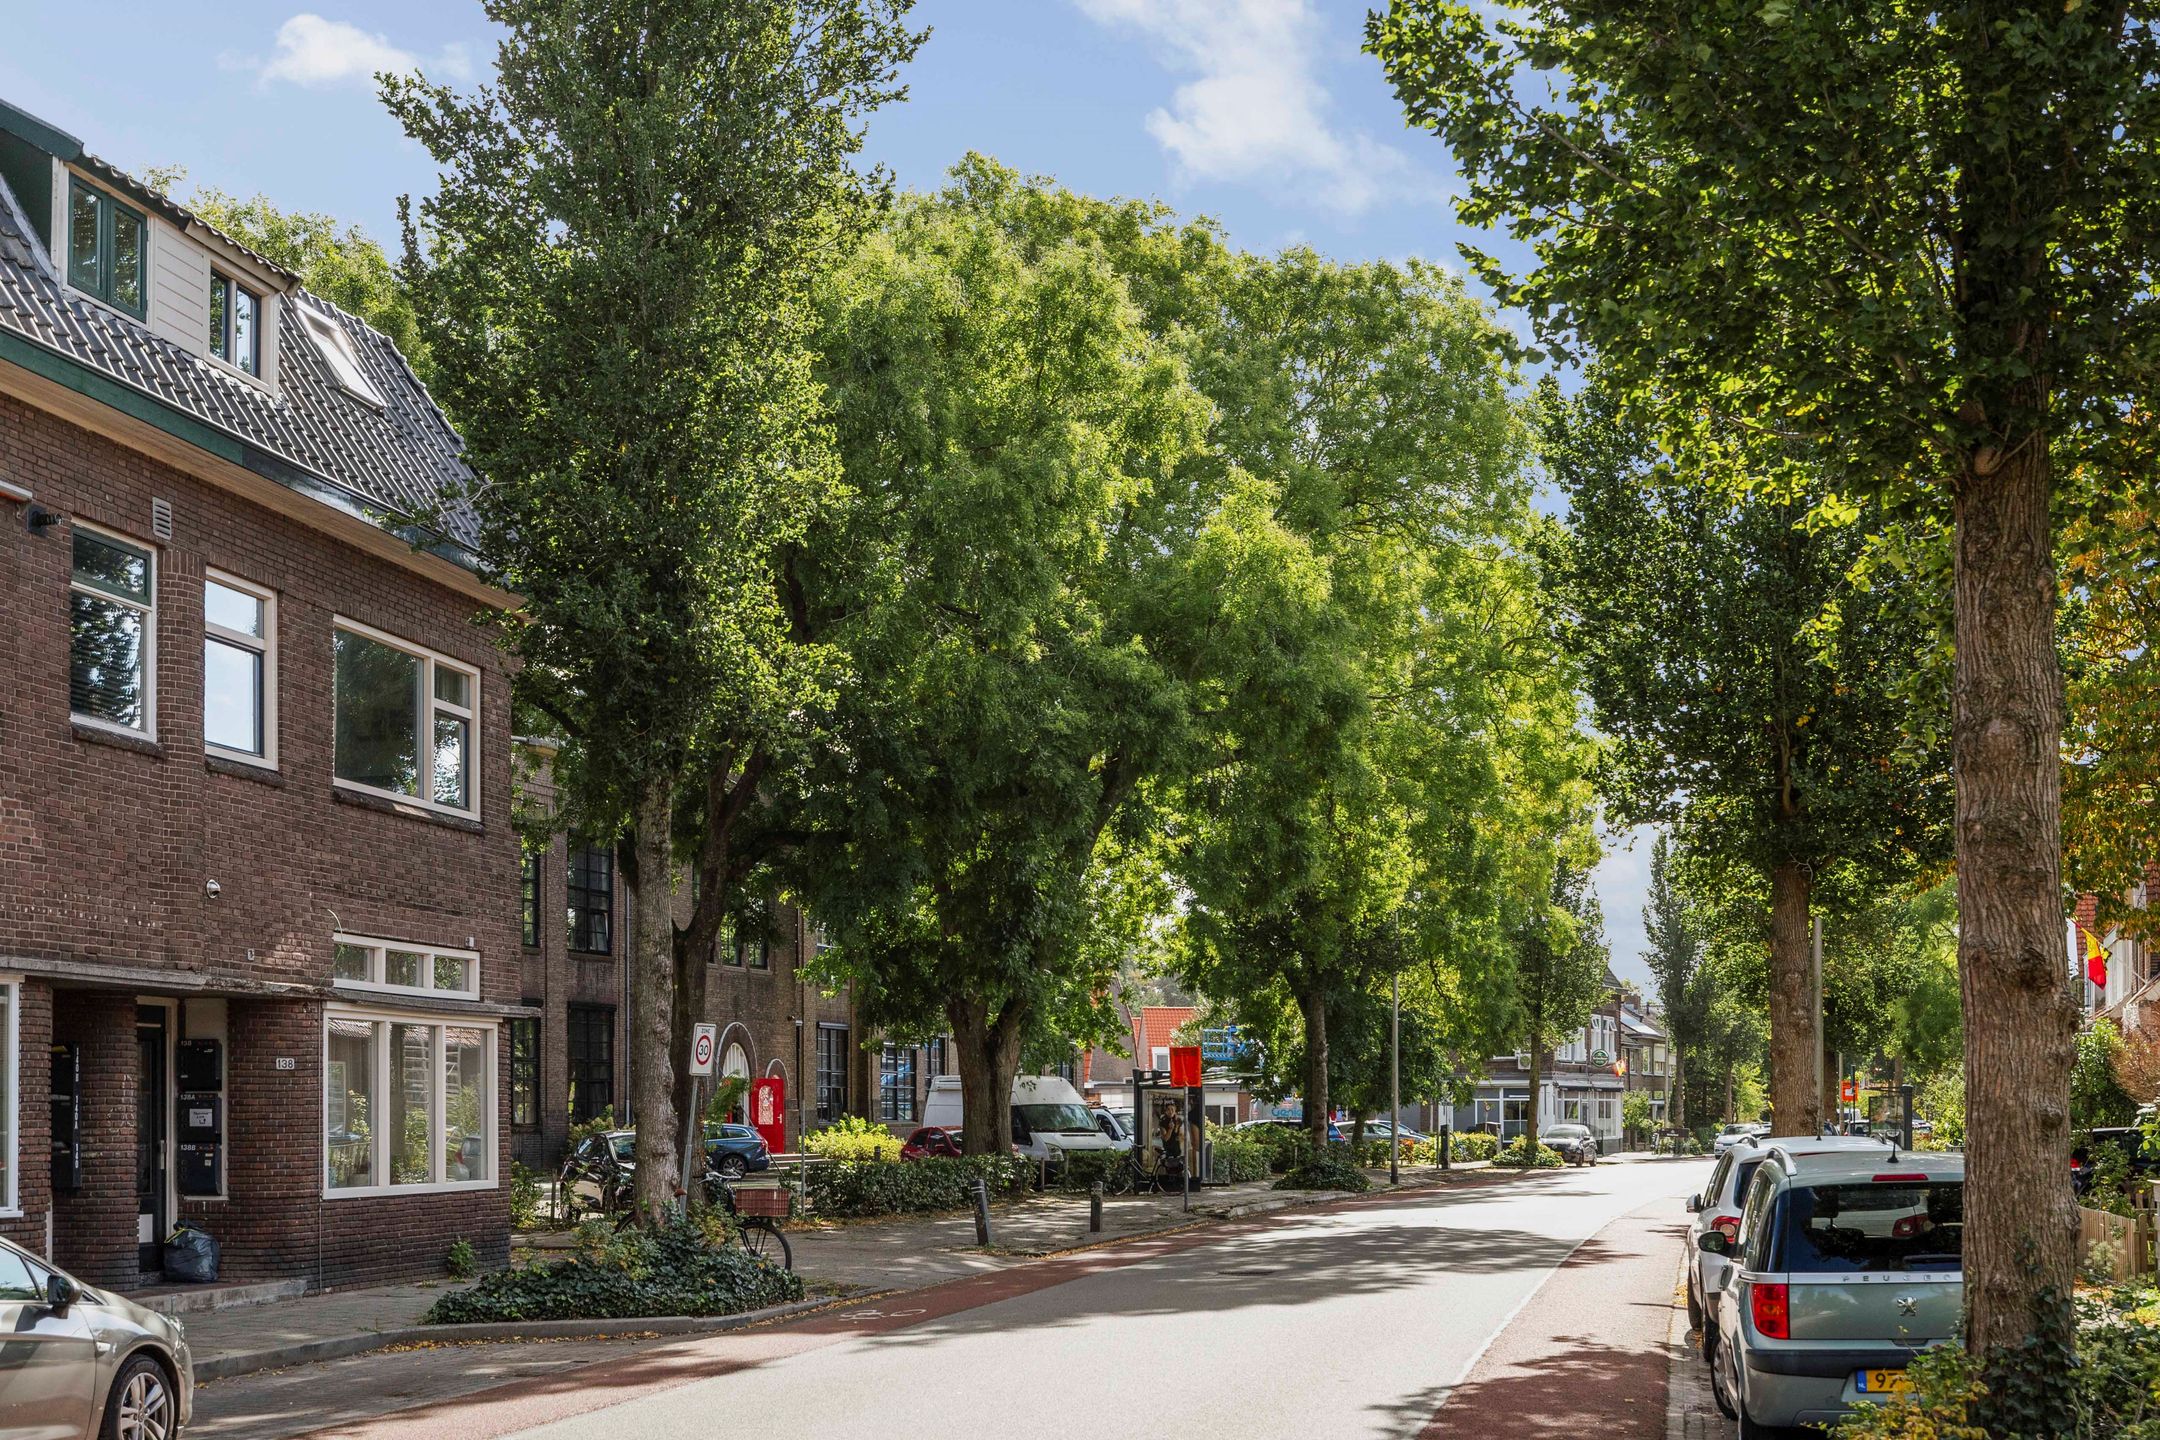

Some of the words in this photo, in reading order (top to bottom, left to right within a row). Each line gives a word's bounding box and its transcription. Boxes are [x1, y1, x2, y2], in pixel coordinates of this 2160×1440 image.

[699, 1044, 708, 1055] 30
[278, 1059, 294, 1069] 138
[1841, 1274, 1952, 1282] PEUGEO
[1875, 1372, 1898, 1389] 97
